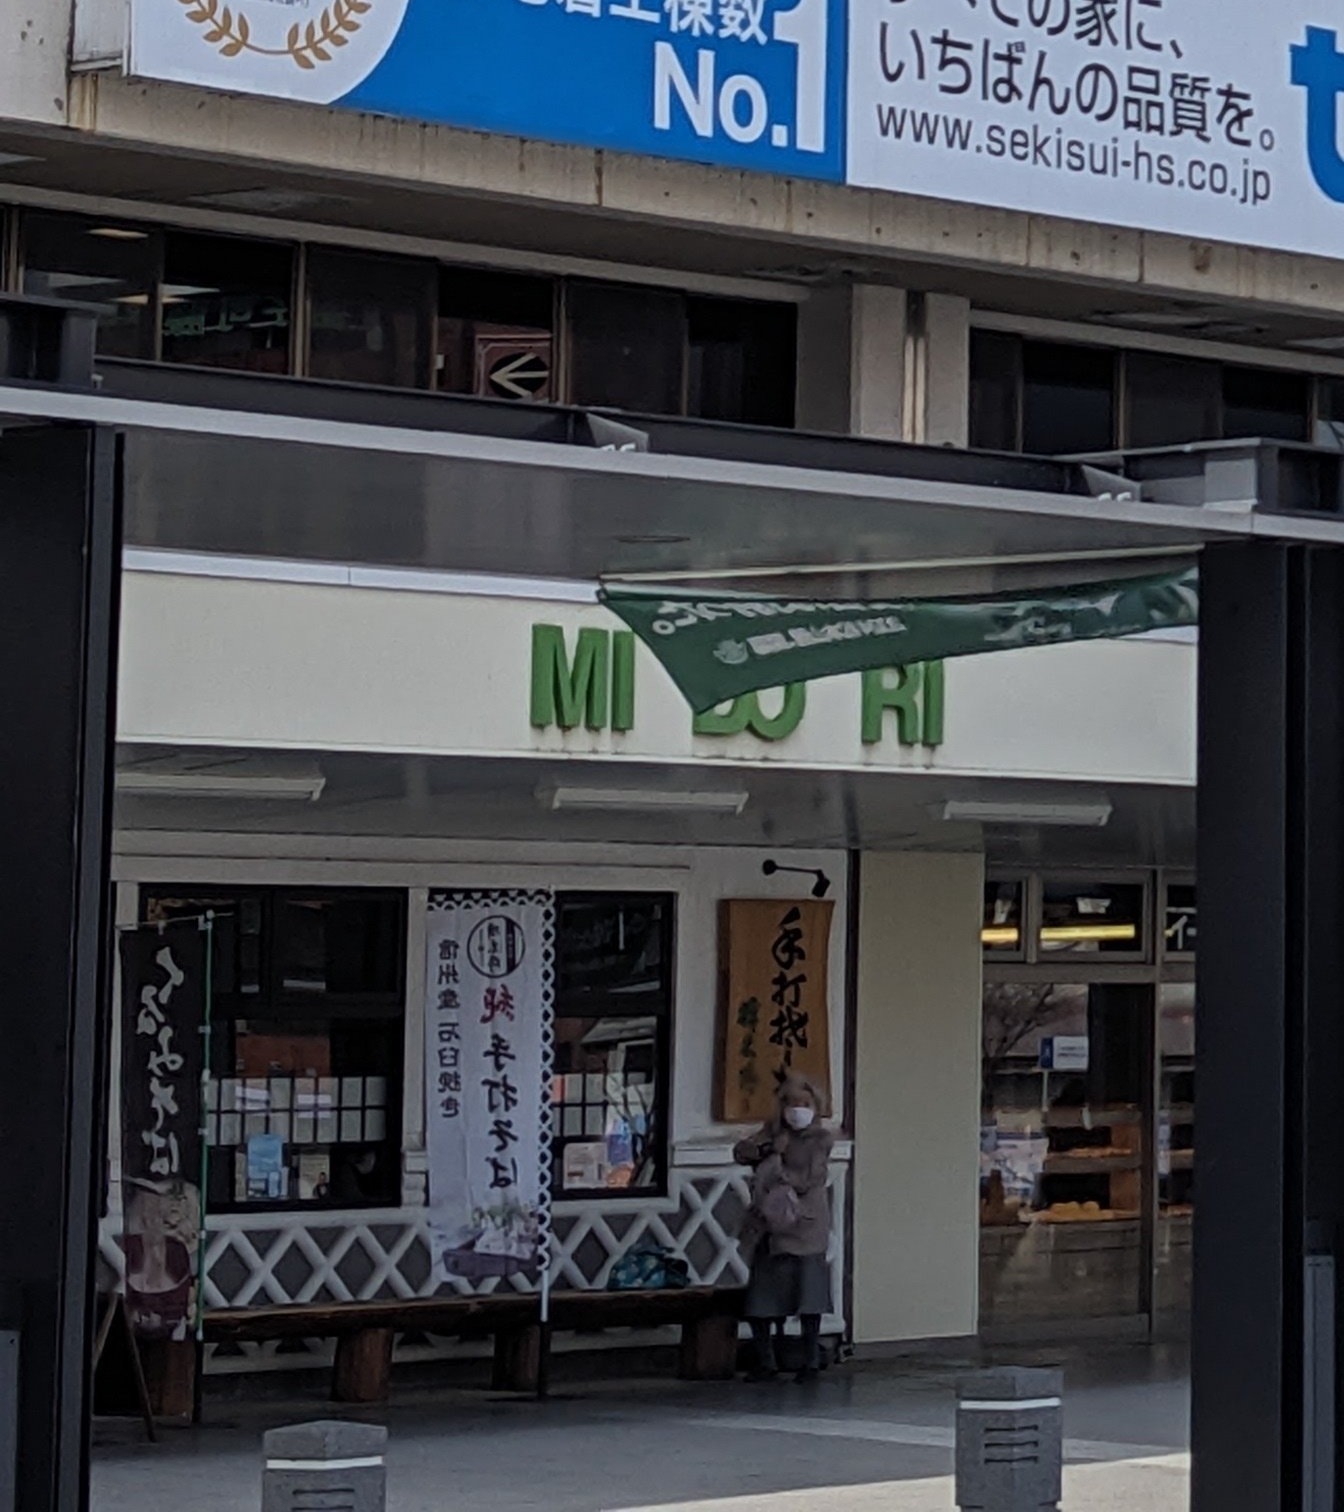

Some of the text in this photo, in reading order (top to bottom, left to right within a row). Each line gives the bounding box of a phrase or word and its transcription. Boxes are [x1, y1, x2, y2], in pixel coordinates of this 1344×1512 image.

[878, 23, 1277, 154] いちばんの品質を。
[876, 104, 1272, 207] www.sekisui-hs.co.jp
